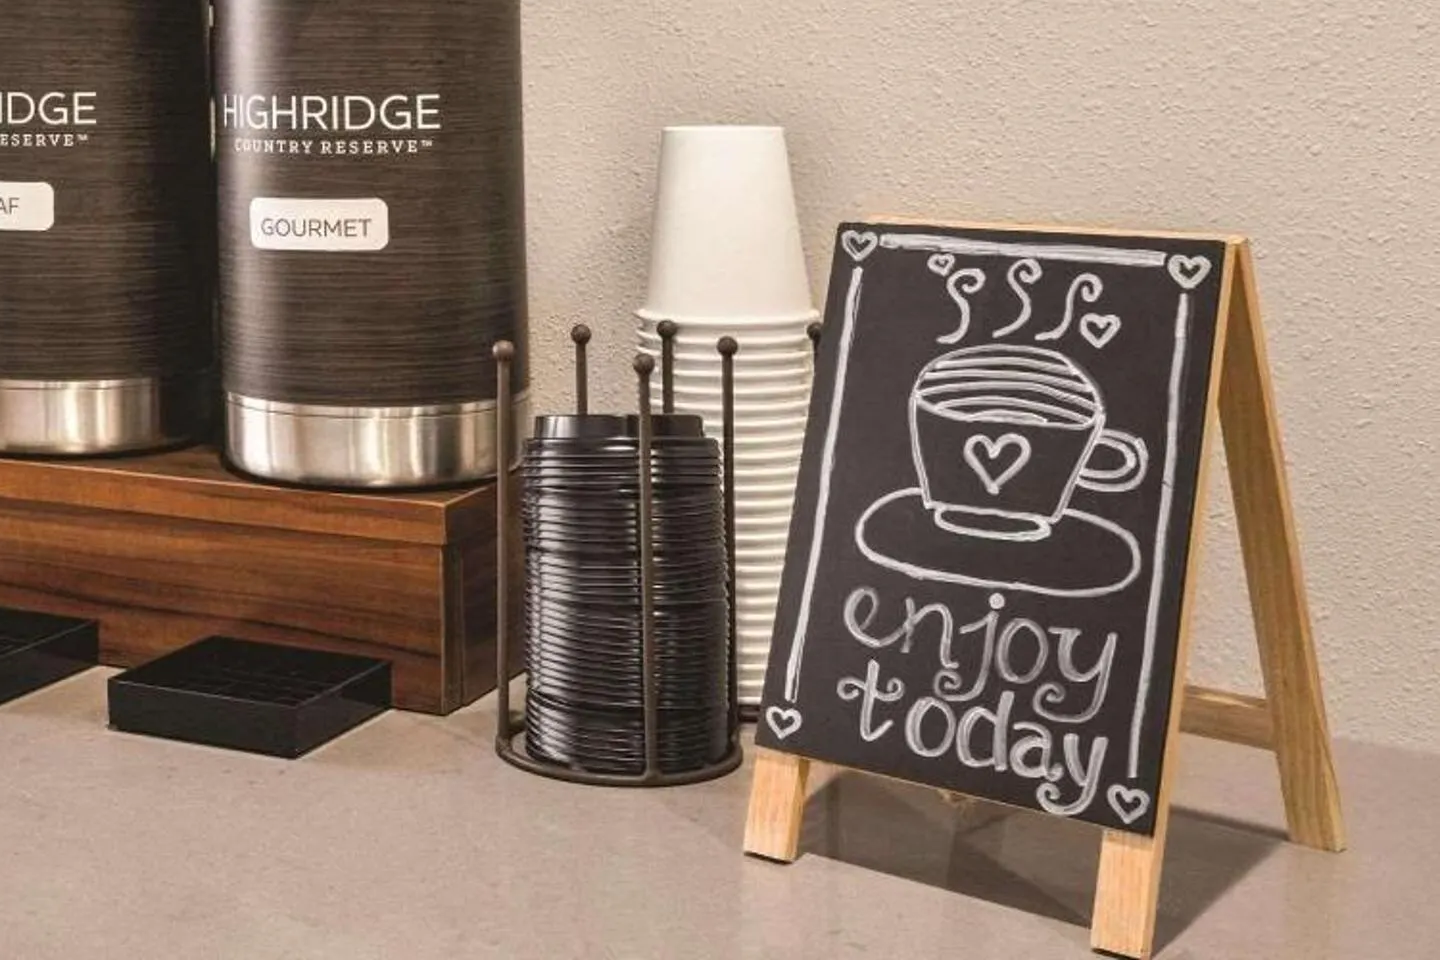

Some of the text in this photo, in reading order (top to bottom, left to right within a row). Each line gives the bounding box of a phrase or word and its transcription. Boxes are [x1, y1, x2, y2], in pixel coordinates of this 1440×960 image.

[223, 93, 442, 131] HIGHRIDGE
[235, 138, 313, 154] COUNTRY
[260, 217, 372, 238] GOURMET
[843, 587, 1119, 724] enjoy
[836, 658, 1110, 816] today
